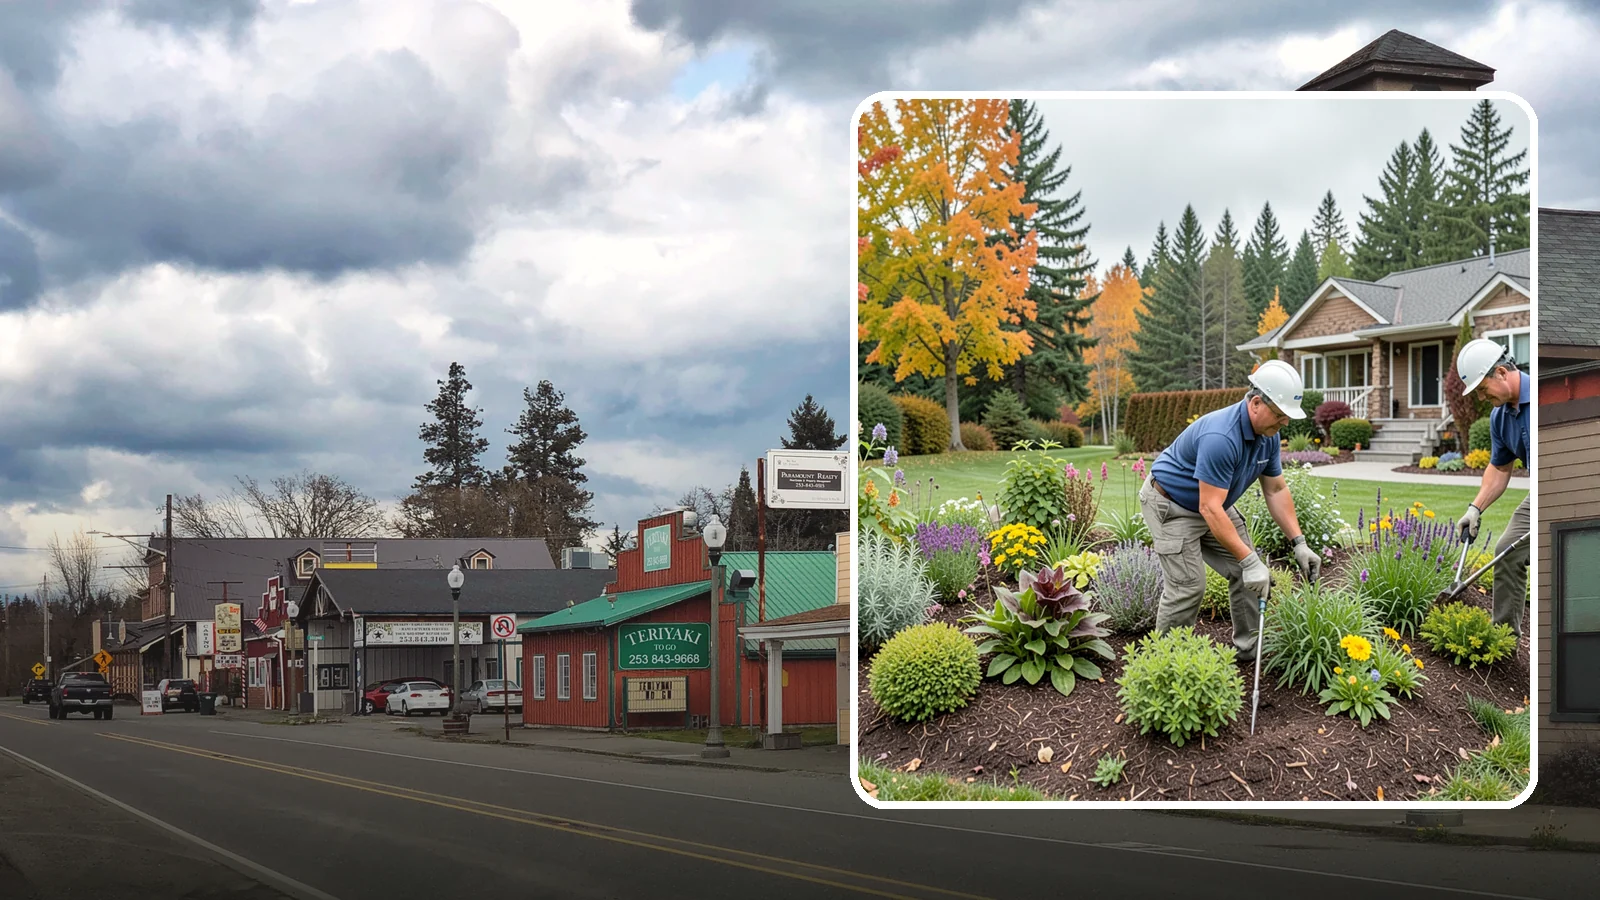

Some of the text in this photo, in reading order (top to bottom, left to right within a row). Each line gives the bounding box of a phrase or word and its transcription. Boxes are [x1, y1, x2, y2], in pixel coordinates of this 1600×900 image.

[625, 627, 702, 646] TERIYAKI
[629, 654, 700, 664] 253 843-9668
